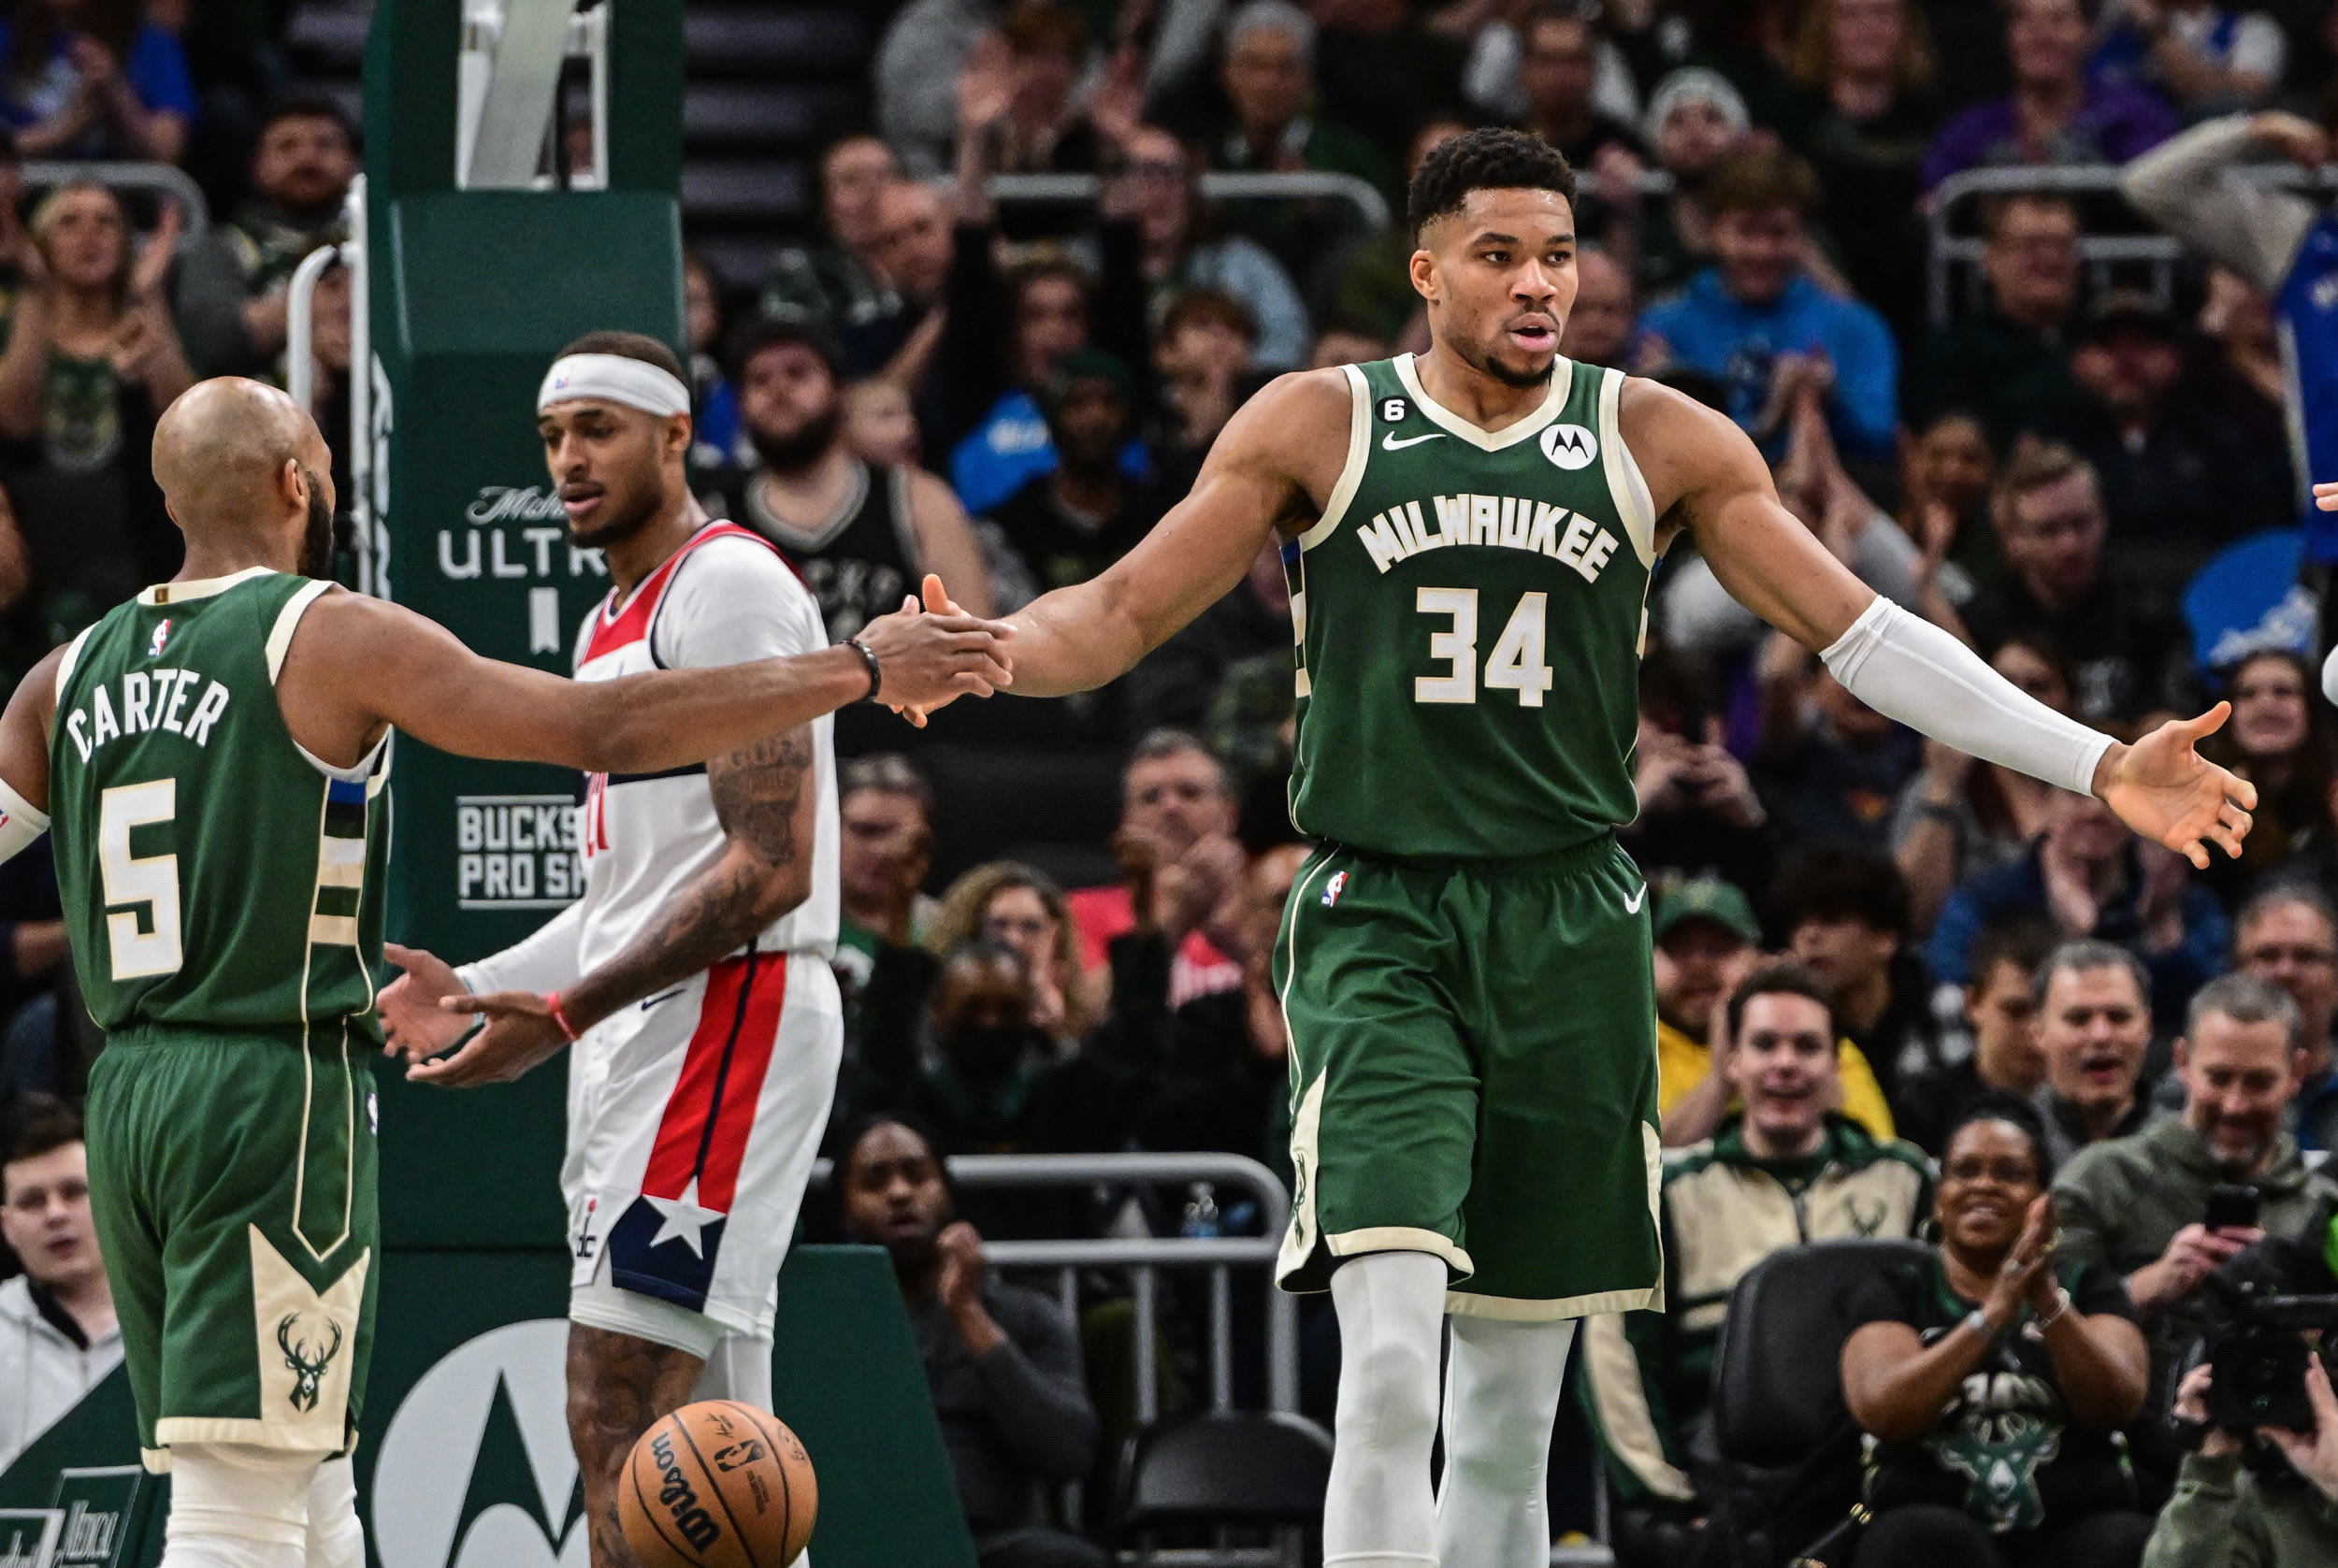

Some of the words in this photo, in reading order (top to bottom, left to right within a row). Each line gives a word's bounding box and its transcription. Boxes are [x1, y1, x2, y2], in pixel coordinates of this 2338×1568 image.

[1383, 397, 1406, 422] 6
[467, 485, 568, 525] Mich
[1356, 493, 1620, 584] MILWAUKEE
[438, 527, 608, 580] ULTR
[1414, 586, 1553, 708] 34
[66, 668, 230, 765] CARTER
[457, 805, 578, 853] BUCKS
[98, 777, 184, 982] 5
[457, 853, 536, 899] PRO
[650, 1431, 721, 1556] Wilson
